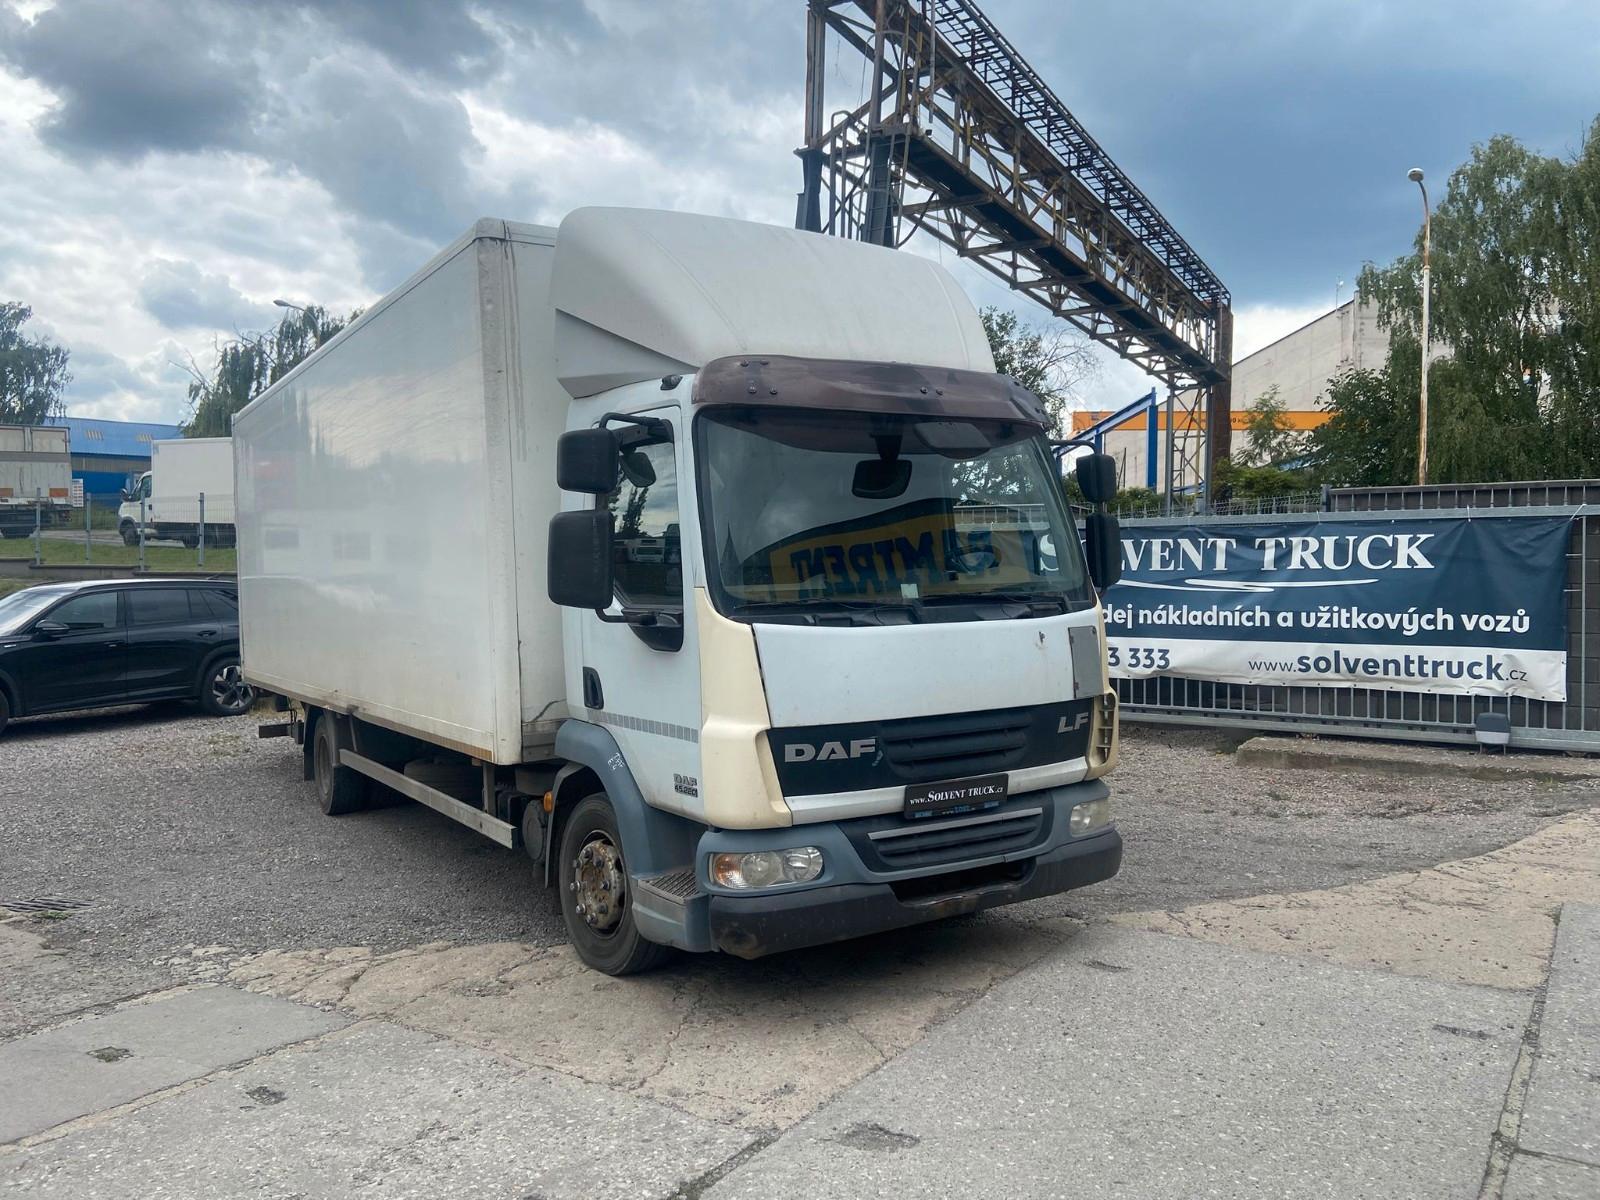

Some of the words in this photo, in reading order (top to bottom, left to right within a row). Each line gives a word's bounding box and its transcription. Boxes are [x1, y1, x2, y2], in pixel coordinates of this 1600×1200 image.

[1121, 538, 1237, 571] VENT
[1255, 533, 1435, 571] TRUCK
[1102, 603, 1133, 629] dej
[1138, 604, 1270, 627] nákladních
[1276, 611, 1294, 628] a
[1300, 605, 1454, 637] užitkových
[1460, 608, 1531, 634] vozů
[1108, 646, 1121, 667] 3
[1127, 647, 1170, 670] 333
[1248, 649, 1528, 682] www.solventtruck.cz
[1057, 711, 1089, 734] LF
[784, 738, 876, 763] DAF
[673, 773, 698, 786] DAF
